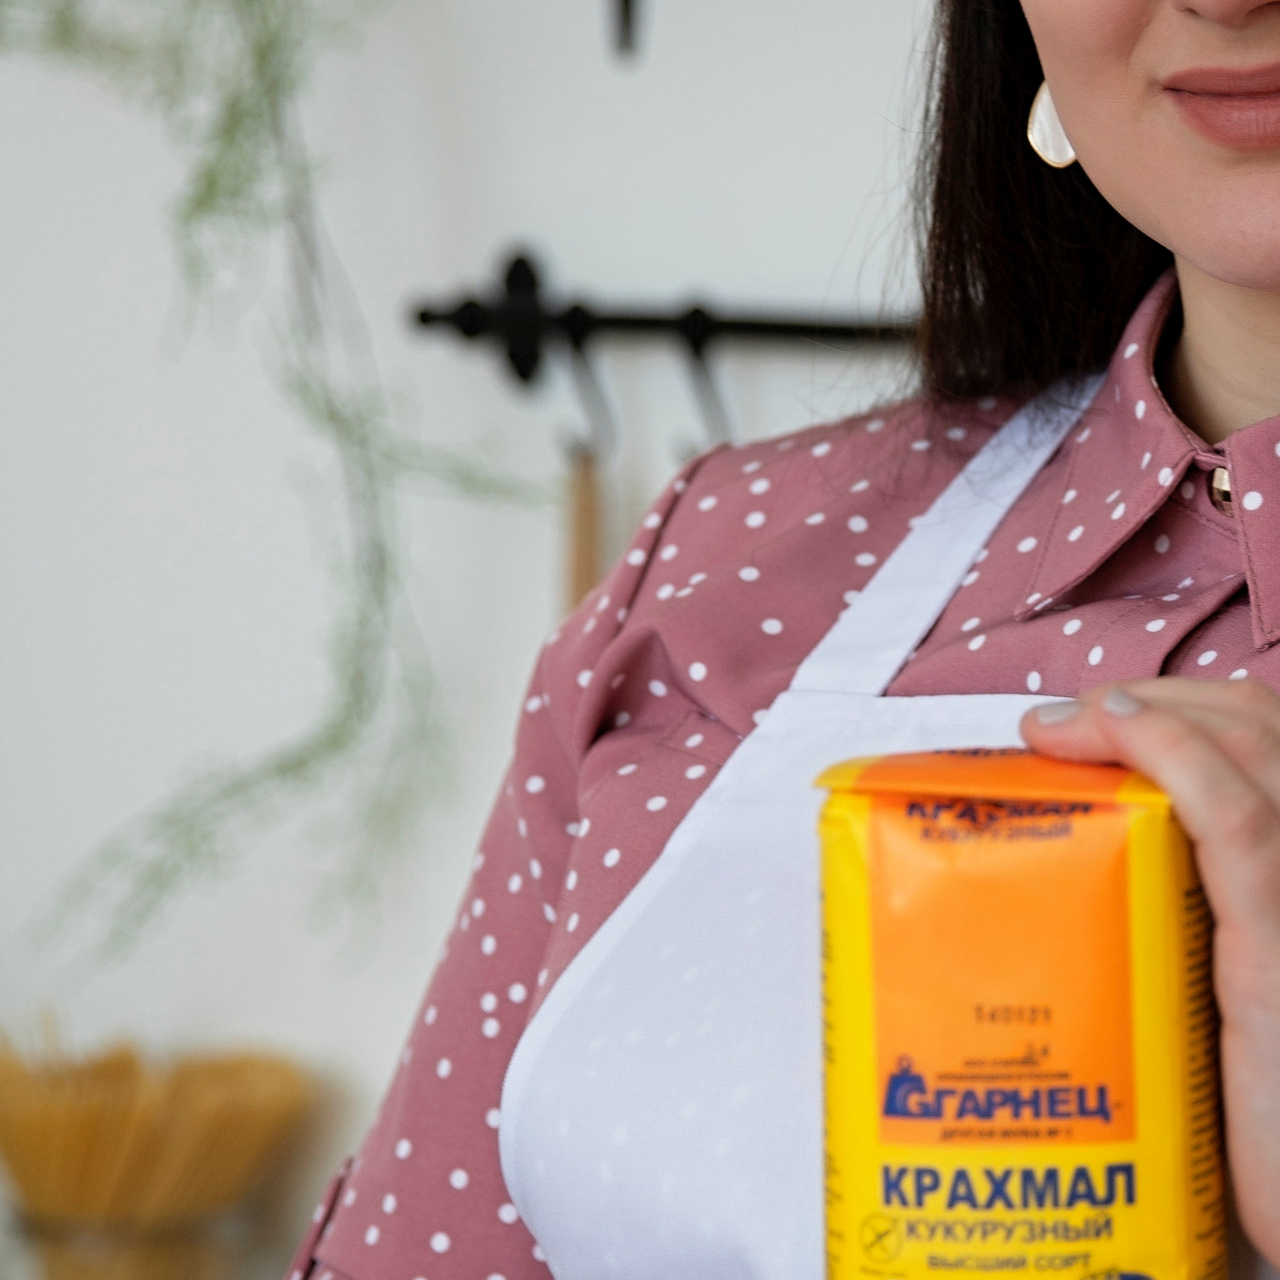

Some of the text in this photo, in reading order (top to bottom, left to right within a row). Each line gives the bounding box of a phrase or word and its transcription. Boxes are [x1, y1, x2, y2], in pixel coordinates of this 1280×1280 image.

[934, 1086, 1112, 1124] ГАРНЕЦ
[881, 1163, 1136, 1210] КРАХМАЛ
[905, 1213, 1114, 1243] КУКУРУЗНЫЙ
[927, 1252, 1093, 1271] ВЫСШИЙ СОРТ
